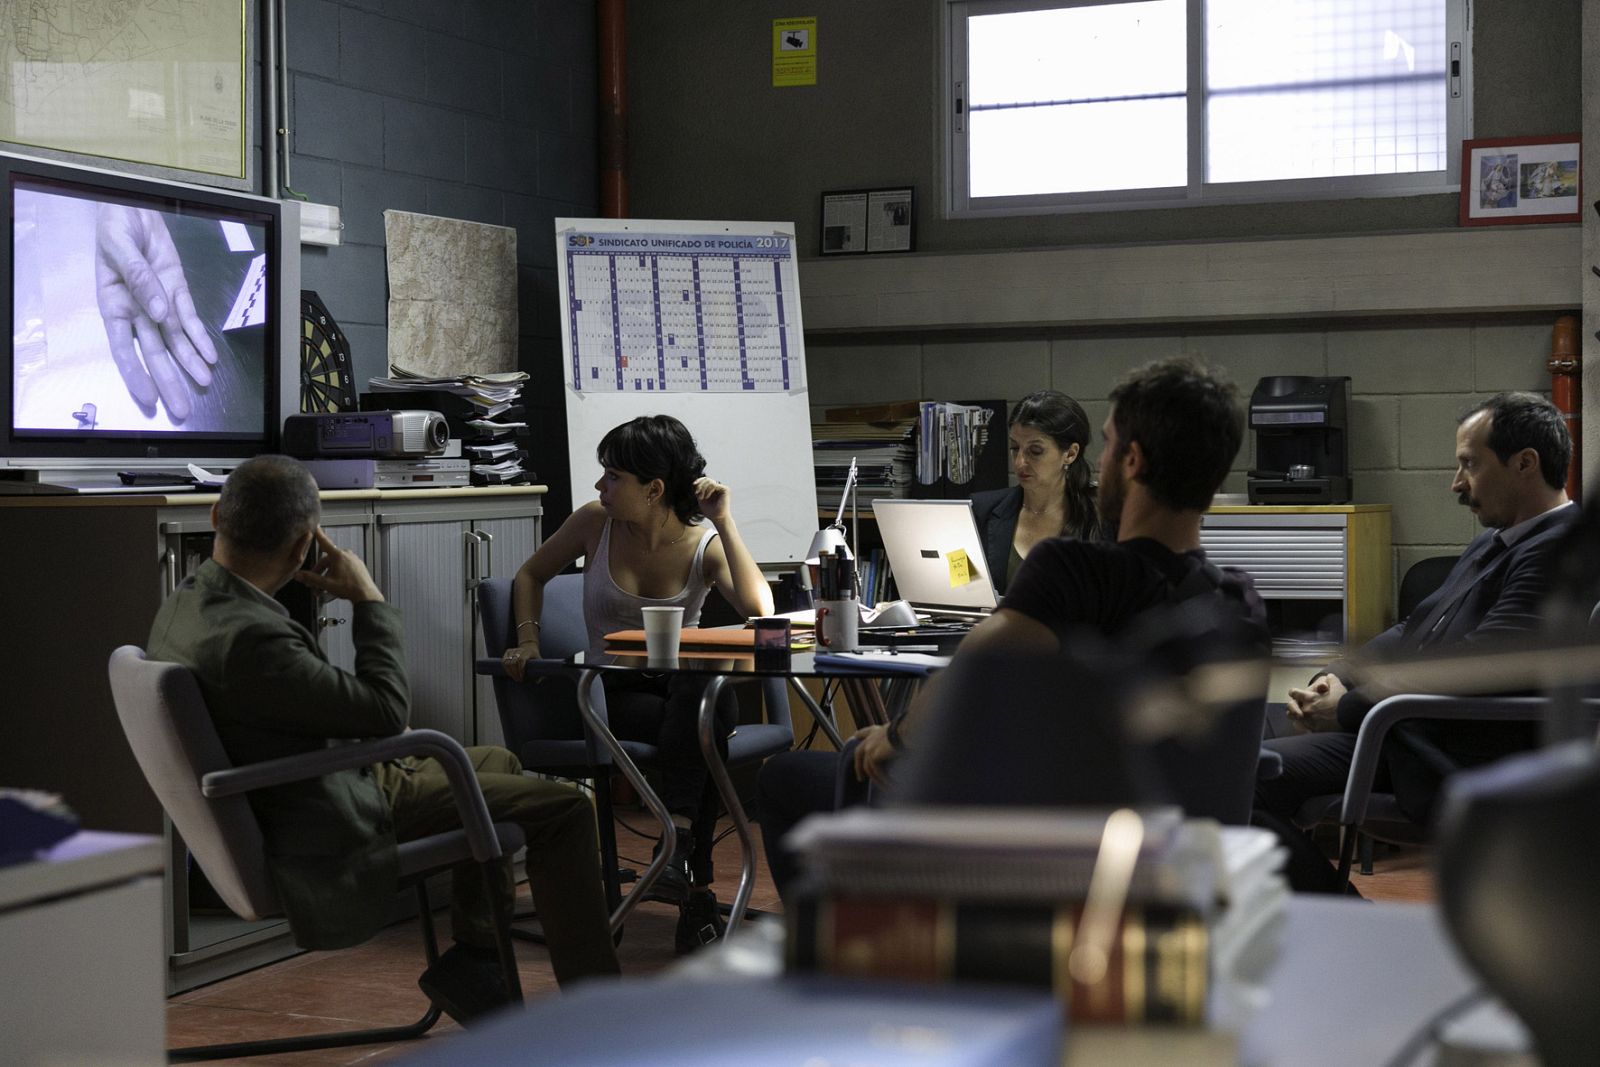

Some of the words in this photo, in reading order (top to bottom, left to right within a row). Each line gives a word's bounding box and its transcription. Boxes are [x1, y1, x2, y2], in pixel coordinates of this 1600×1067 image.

[598, 238, 649, 247] SINDICATO
[651, 239, 701, 248] UNIFICADO
[704, 240, 716, 248] DE
[756, 237, 788, 249] 2017
[320, 315, 327, 325] 18
[339, 353, 345, 362] 13
[344, 375, 349, 384] 6
